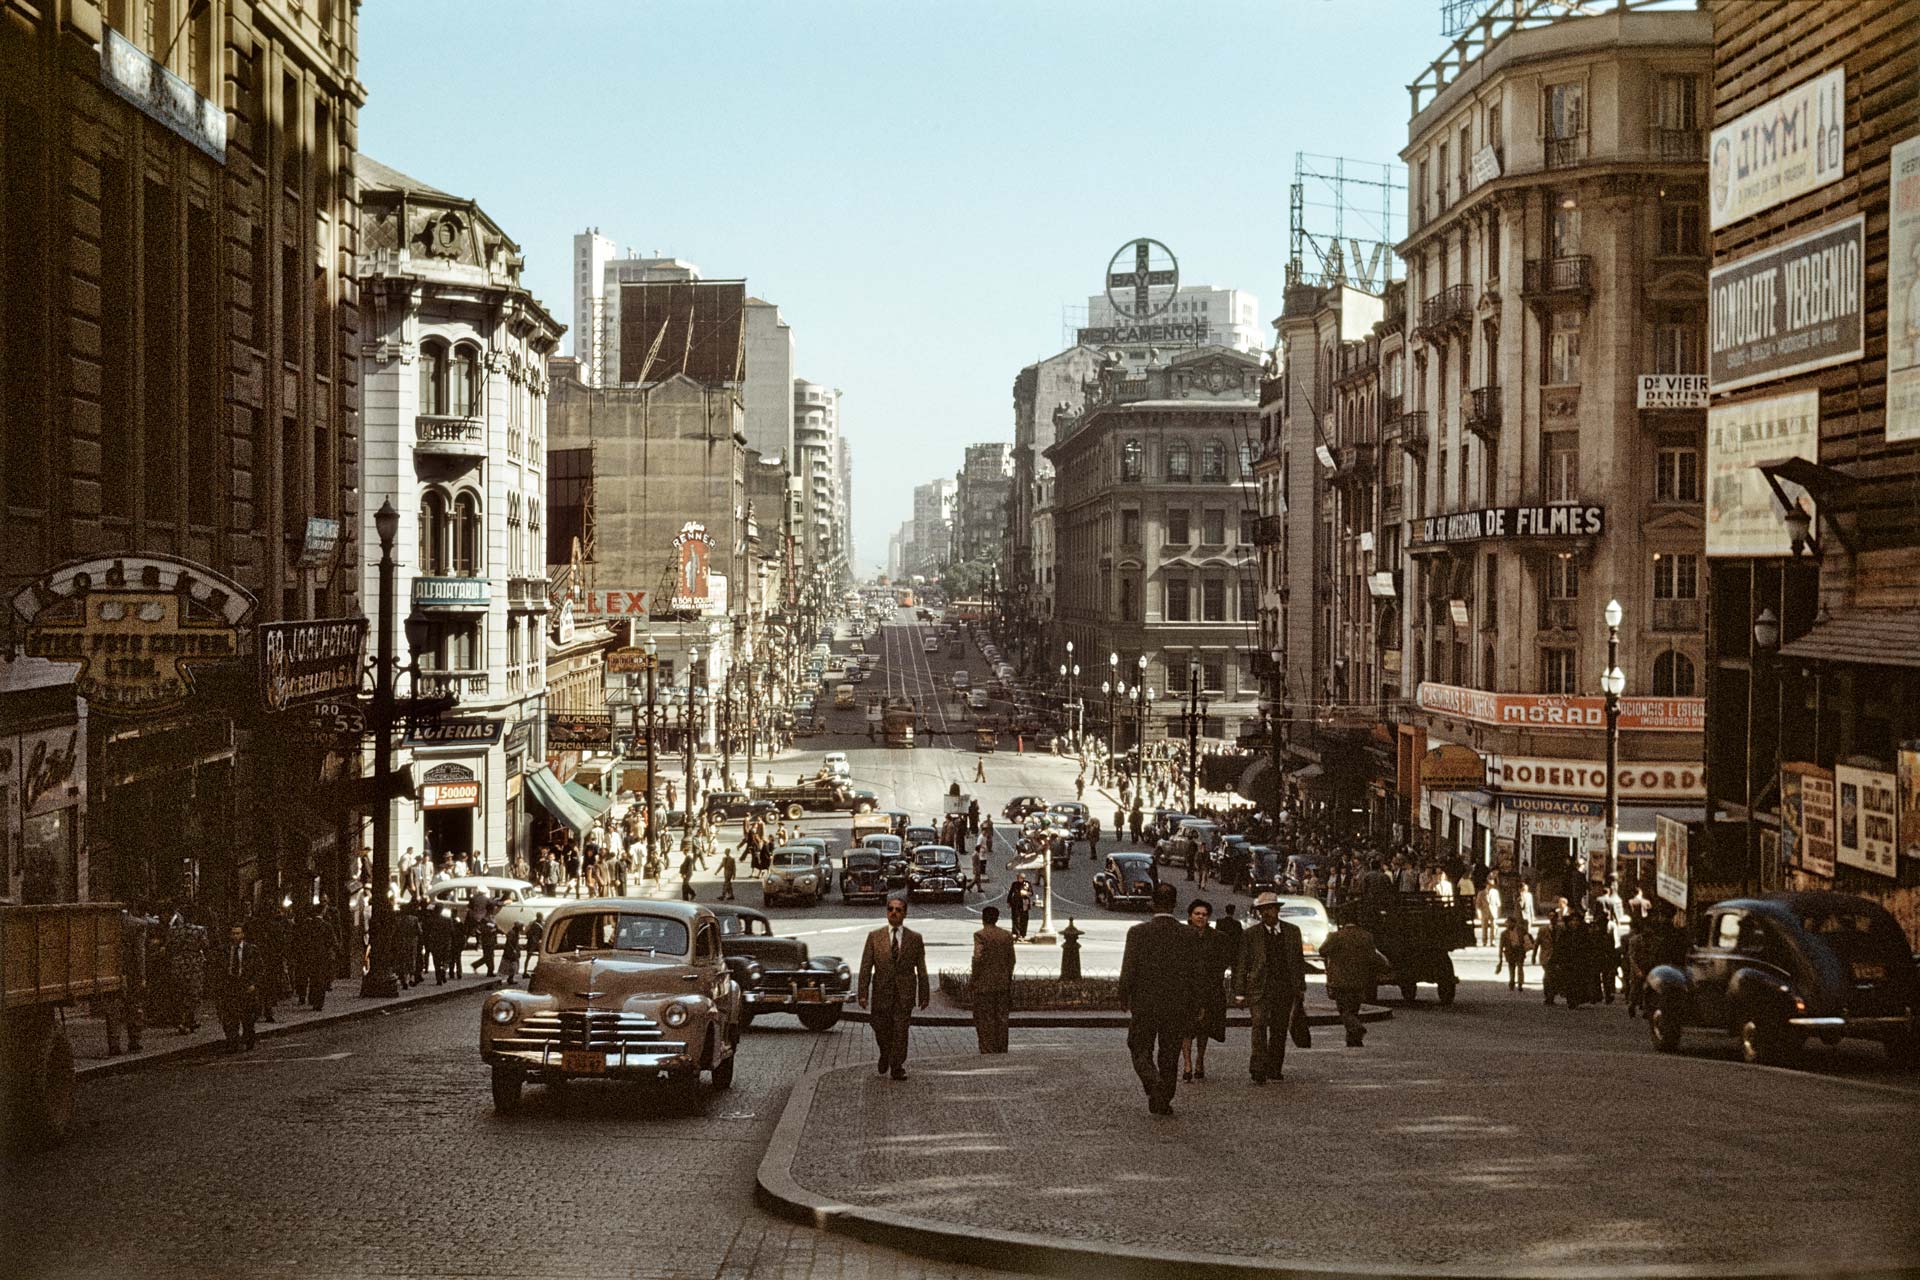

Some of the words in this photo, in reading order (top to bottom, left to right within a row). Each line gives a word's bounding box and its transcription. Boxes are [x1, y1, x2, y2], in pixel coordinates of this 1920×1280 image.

[1737, 98, 1808, 179] JIMMI
[1112, 271, 1174, 288] BAYER
[1713, 267, 1777, 352] LANOLEITE
[1784, 240, 1857, 331] VERBENIA
[1079, 322, 1208, 344] MEDICAMENTOS
[1646, 392, 1708, 400] DENTIST
[1486, 509, 1505, 536] DE
[1517, 507, 1601, 534] FILMES
[672, 533, 717, 548] RENNER
[1503, 705, 1602, 724] MORAD
[414, 724, 494, 740] LOTERIAS
[1503, 764, 1604, 787] ROBERTO
[1513, 798, 1589, 812] LIQUIDAÇÃO
